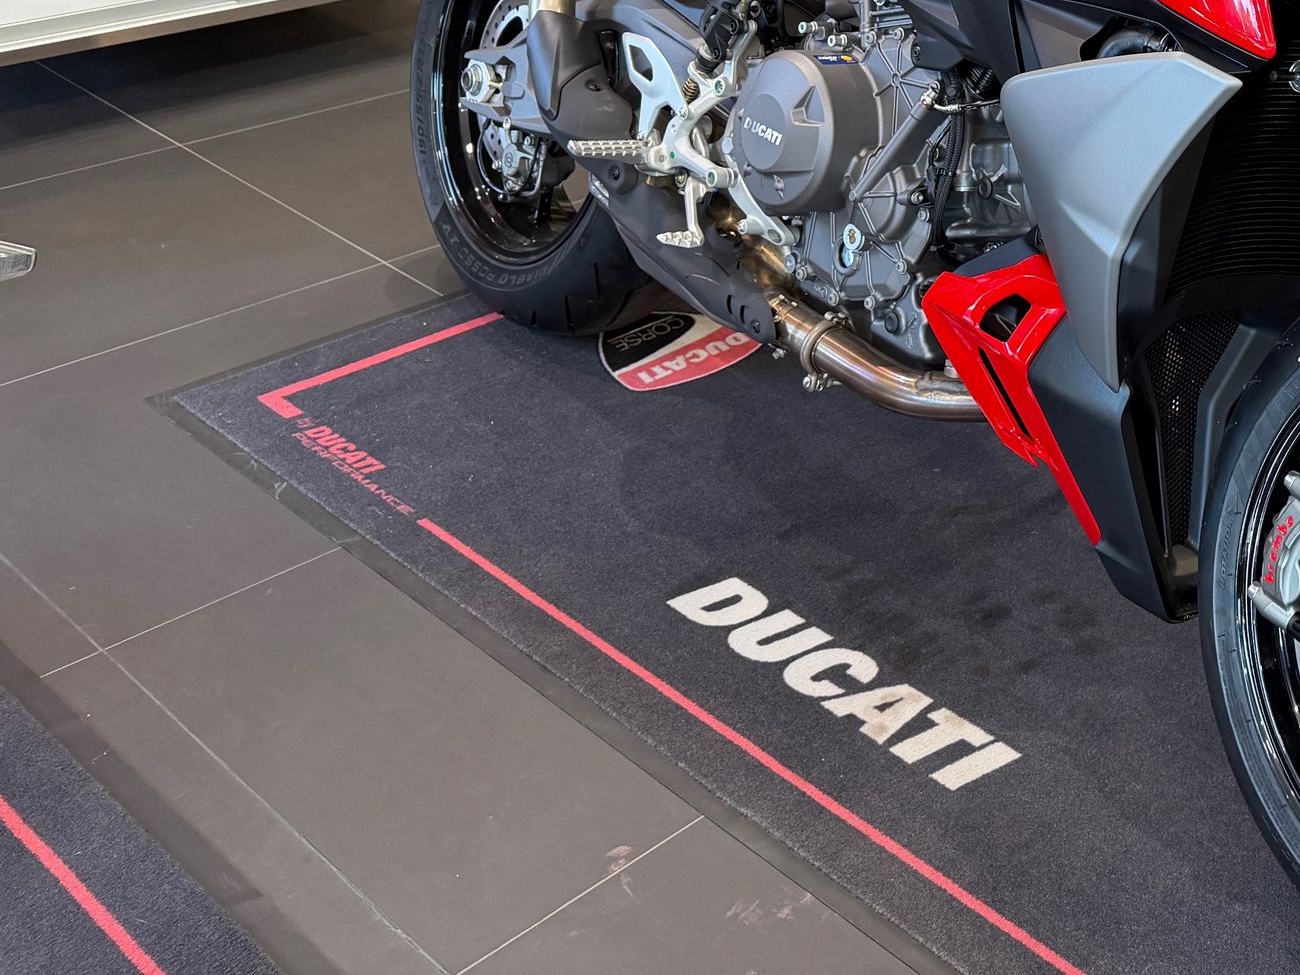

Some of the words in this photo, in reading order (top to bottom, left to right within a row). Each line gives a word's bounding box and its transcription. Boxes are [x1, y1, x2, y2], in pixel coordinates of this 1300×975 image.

[743, 116, 783, 146] DUCATI
[614, 317, 685, 352] CORSE
[637, 331, 751, 384] DUCATI
[291, 432, 416, 517] PERFORMANCE
[303, 425, 387, 474] DUCATI
[1263, 515, 1295, 585] brembo
[666, 576, 1023, 792] DUCATI
